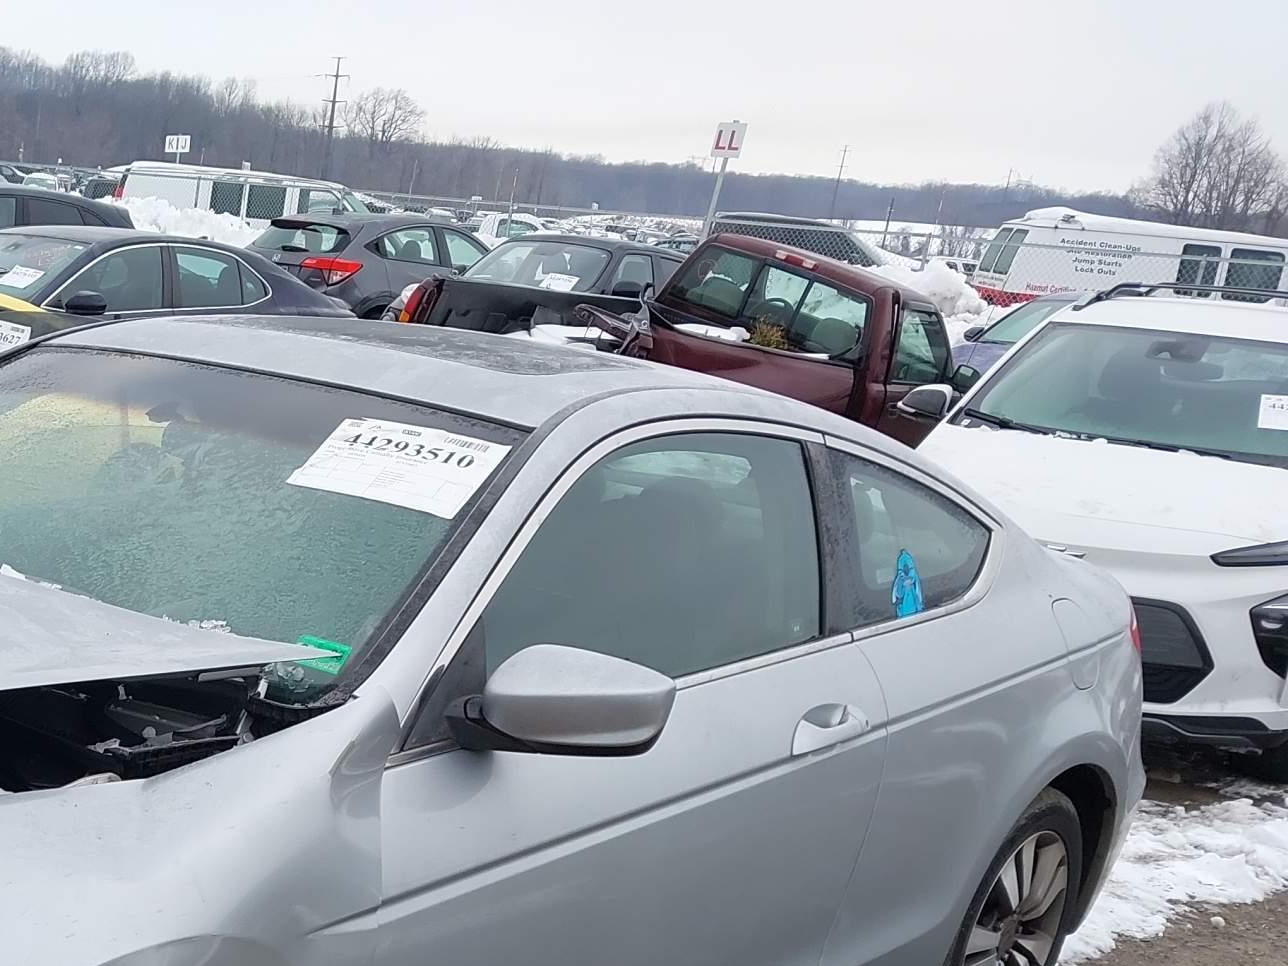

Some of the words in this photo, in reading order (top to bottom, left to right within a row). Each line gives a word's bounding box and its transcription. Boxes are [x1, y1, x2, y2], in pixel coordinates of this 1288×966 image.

[714, 129, 739, 151] LL
[1059, 237, 1097, 247] Accident
[1099, 241, 1142, 252] Clean-Ups
[1072, 256, 1096, 265] Jump
[1097, 258, 1122, 267] Starts
[1074, 265, 1094, 274] Lock
[1097, 267, 1116, 276] Outs
[344, 432, 476, 470] 44293510
